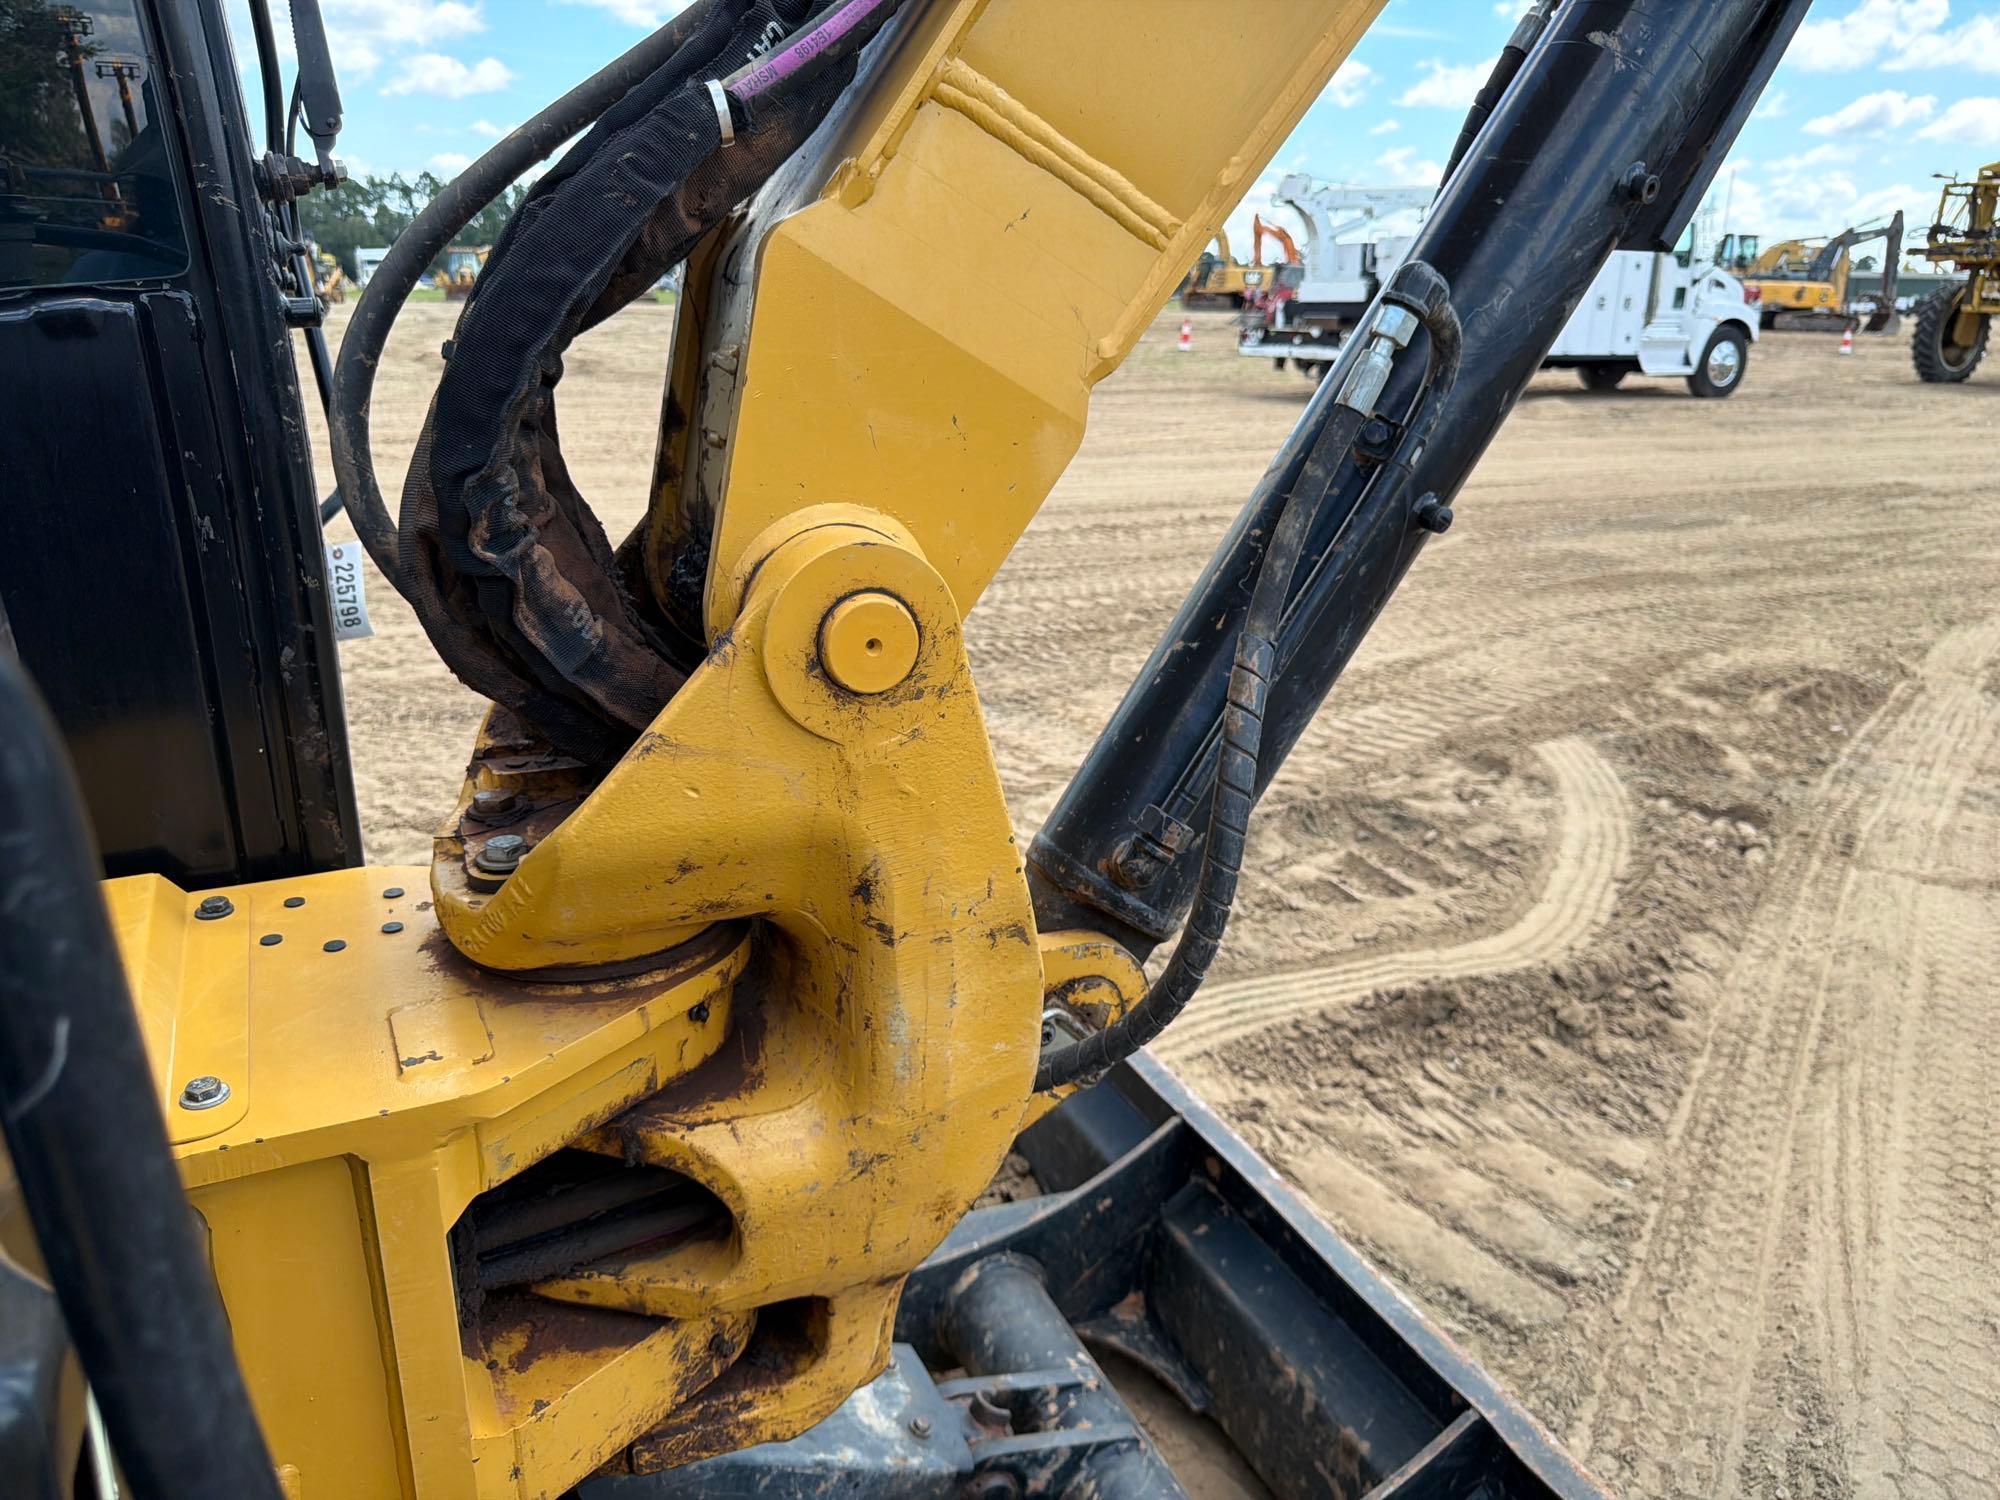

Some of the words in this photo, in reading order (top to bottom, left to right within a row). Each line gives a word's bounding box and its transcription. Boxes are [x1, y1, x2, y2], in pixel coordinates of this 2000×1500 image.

[794, 28, 832, 59] 1E4198
[743, 64, 778, 89] MSHA
[334, 562, 362, 628] 225798
